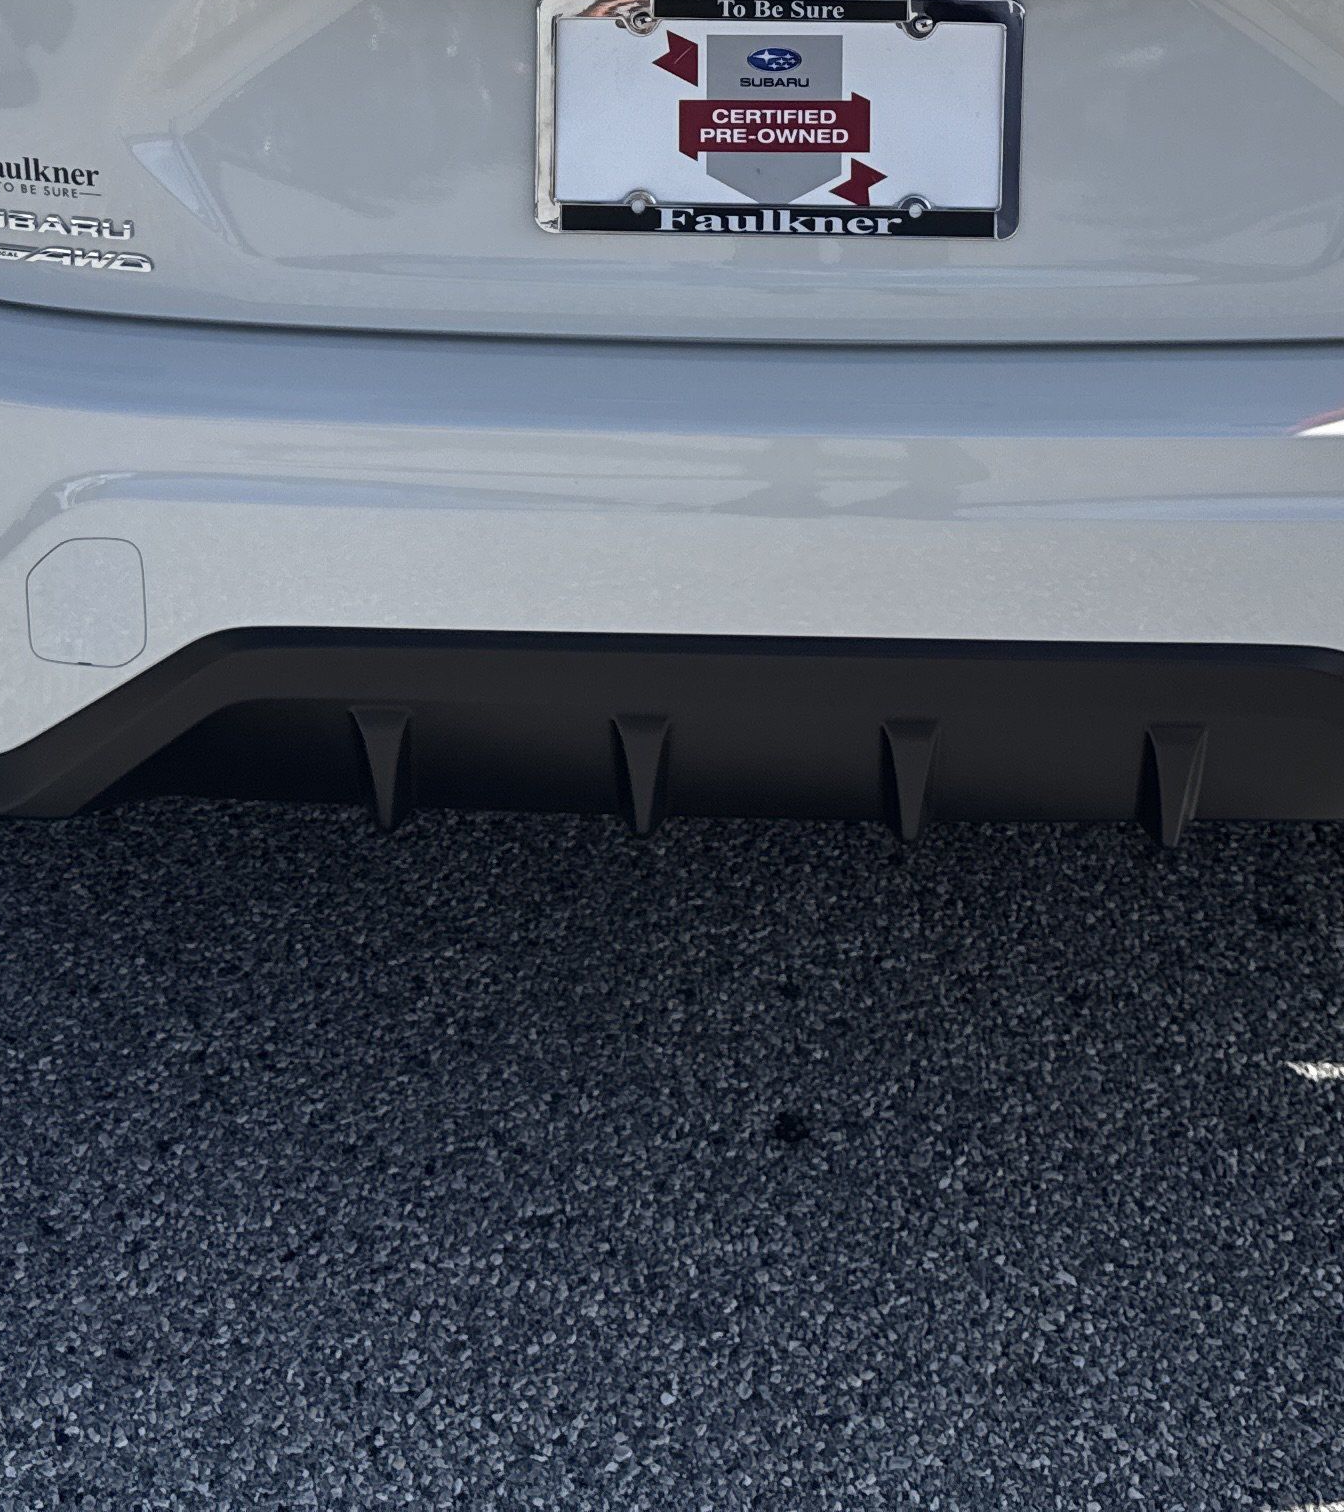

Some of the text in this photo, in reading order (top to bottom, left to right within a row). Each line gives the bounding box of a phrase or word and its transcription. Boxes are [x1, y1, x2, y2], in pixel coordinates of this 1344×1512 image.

[717, 0, 845, 19] To Be Sure
[740, 77, 810, 88] SUBARU
[712, 108, 837, 124] CERTIFIED
[700, 128, 849, 144] PRE-OWNED
[20, 184, 37, 195] BE
[43, 186, 79, 199] SURE
[654, 207, 903, 235] Faulkner
[24, 244, 155, 273] AWD
